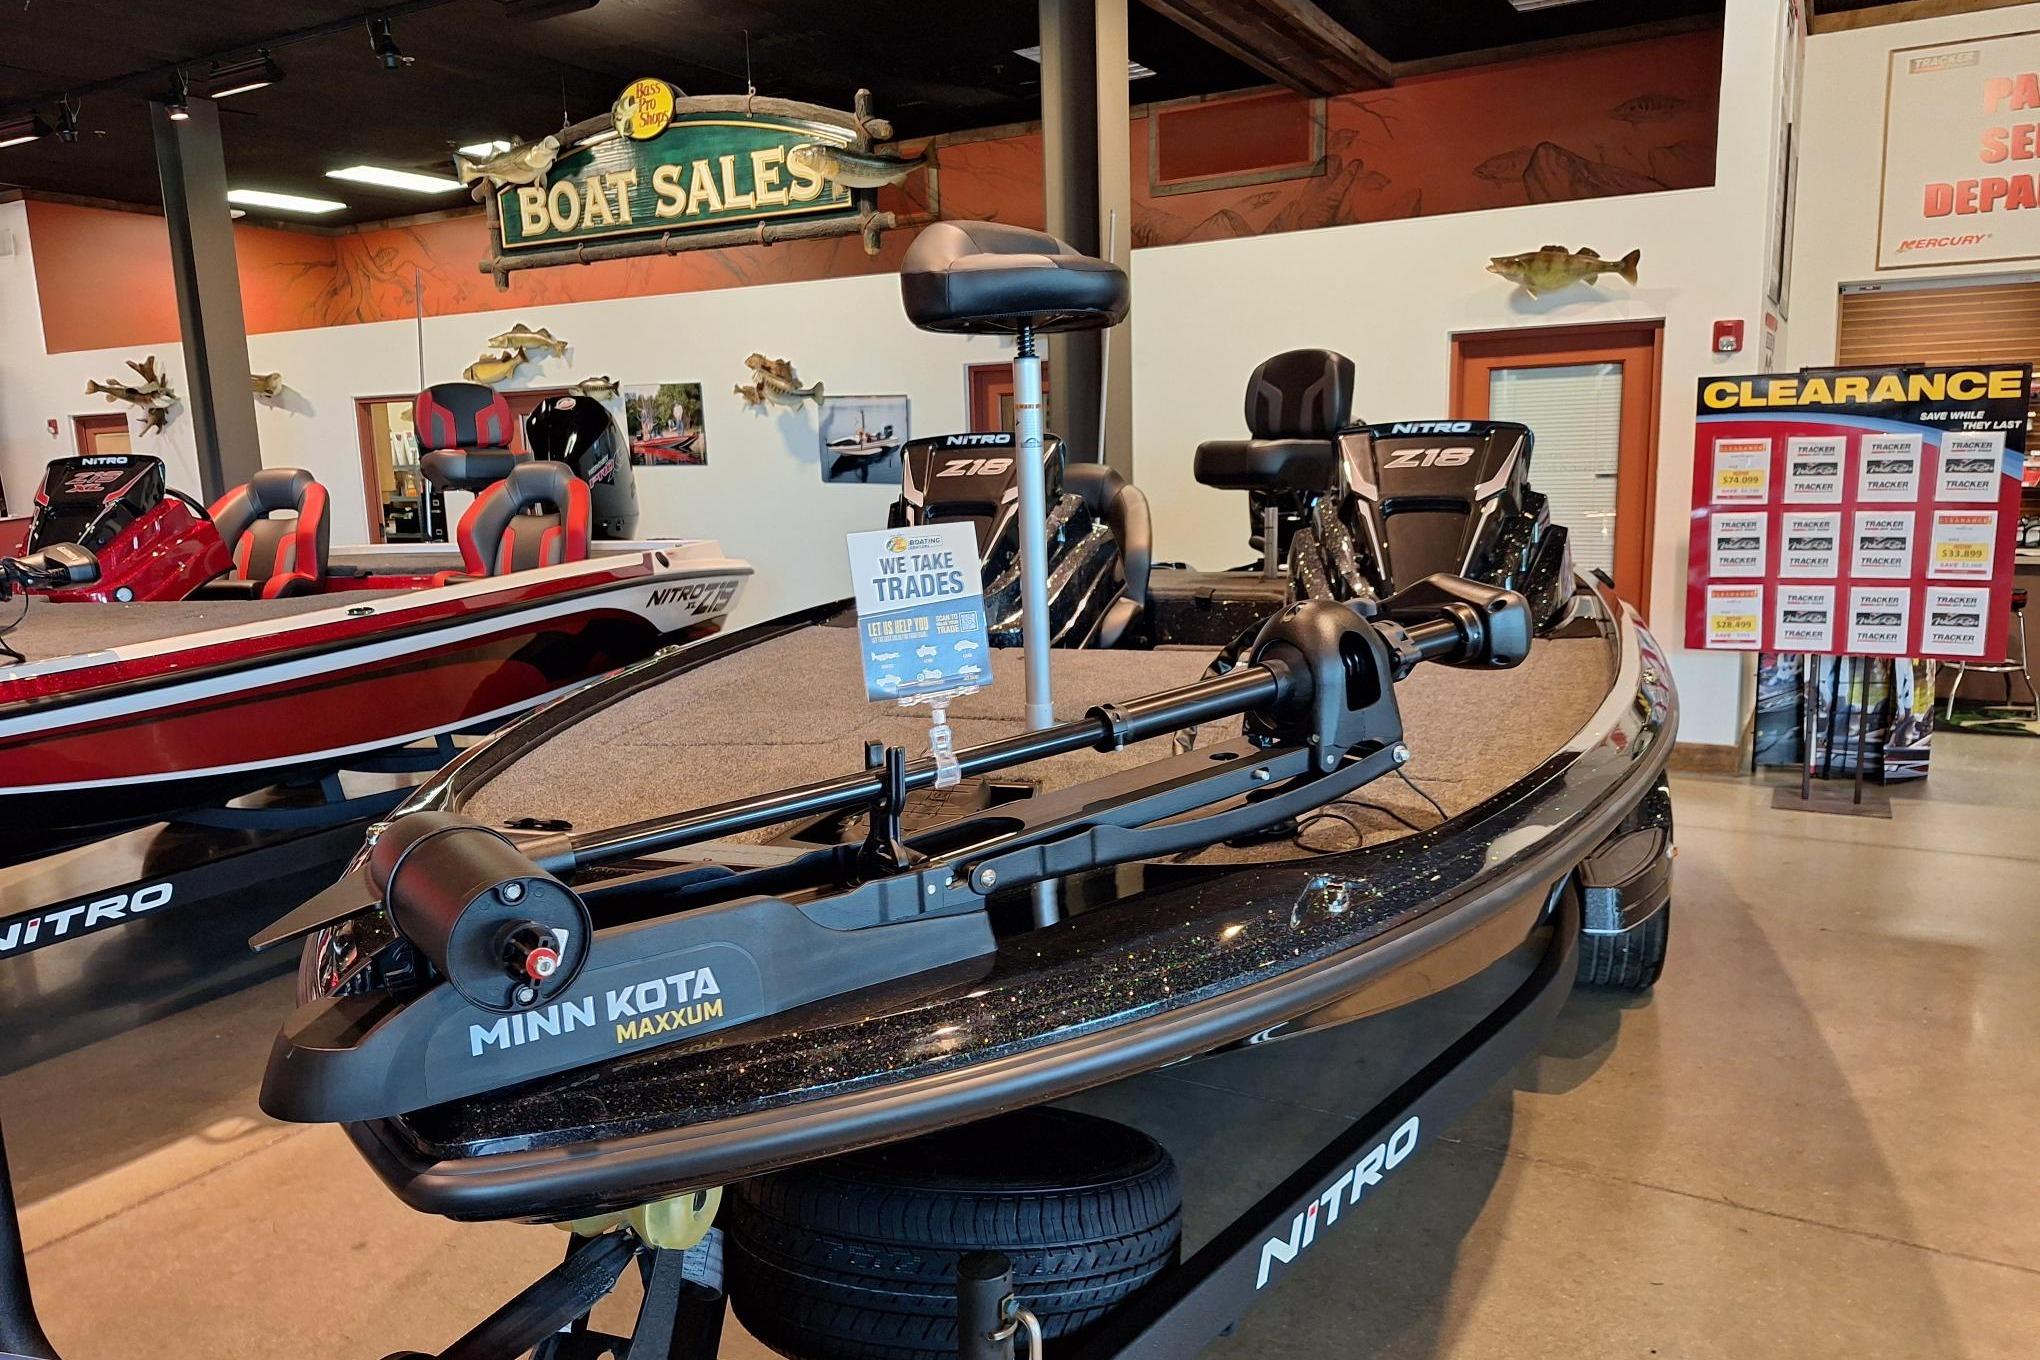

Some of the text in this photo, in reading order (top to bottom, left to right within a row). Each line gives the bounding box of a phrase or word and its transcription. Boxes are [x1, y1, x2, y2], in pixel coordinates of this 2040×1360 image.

[636, 82, 661, 98] Bass
[639, 97, 657, 112] Pro
[640, 111, 669, 127] Shops
[1980, 124, 2040, 164] SE
[517, 143, 825, 237] BOAT SALES
[1923, 174, 2040, 218] DEPA
[1897, 234, 1985, 253] MERCURY
[1703, 370, 2023, 409] CLEARANCE
[1919, 410, 1985, 421] SAVE WHILE
[1391, 422, 1472, 434] NITRO
[1963, 419, 2022, 431] THEY LAST
[946, 434, 1011, 446] NITRO
[82, 457, 128, 466] NITRO
[1383, 447, 1475, 469] Z18
[936, 458, 1014, 478] Z18
[1794, 483, 1834, 491] TRACKER
[1867, 481, 1909, 489] TRACKER
[1946, 480, 1989, 488] TRACKER
[909, 537, 941, 546] BOATING
[879, 551, 954, 575] WE TAKE
[1861, 557, 1902, 565] TRACKER
[872, 570, 964, 602] TRADES
[646, 584, 706, 608] NITRO
[1936, 596, 1977, 604] TRACKER
[867, 622, 881, 637] LET
[882, 620, 892, 635] US
[894, 618, 912, 634] HELP
[913, 616, 929, 631] YOU
[937, 624, 960, 635] TRADE
[1784, 630, 1823, 638] TRACKER
[1932, 633, 1975, 641] TRACKER
[469, 966, 721, 1057] MINN KOTA
[616, 998, 724, 1044] MAXXUM
[1256, 1116, 1420, 1290] NITRO
